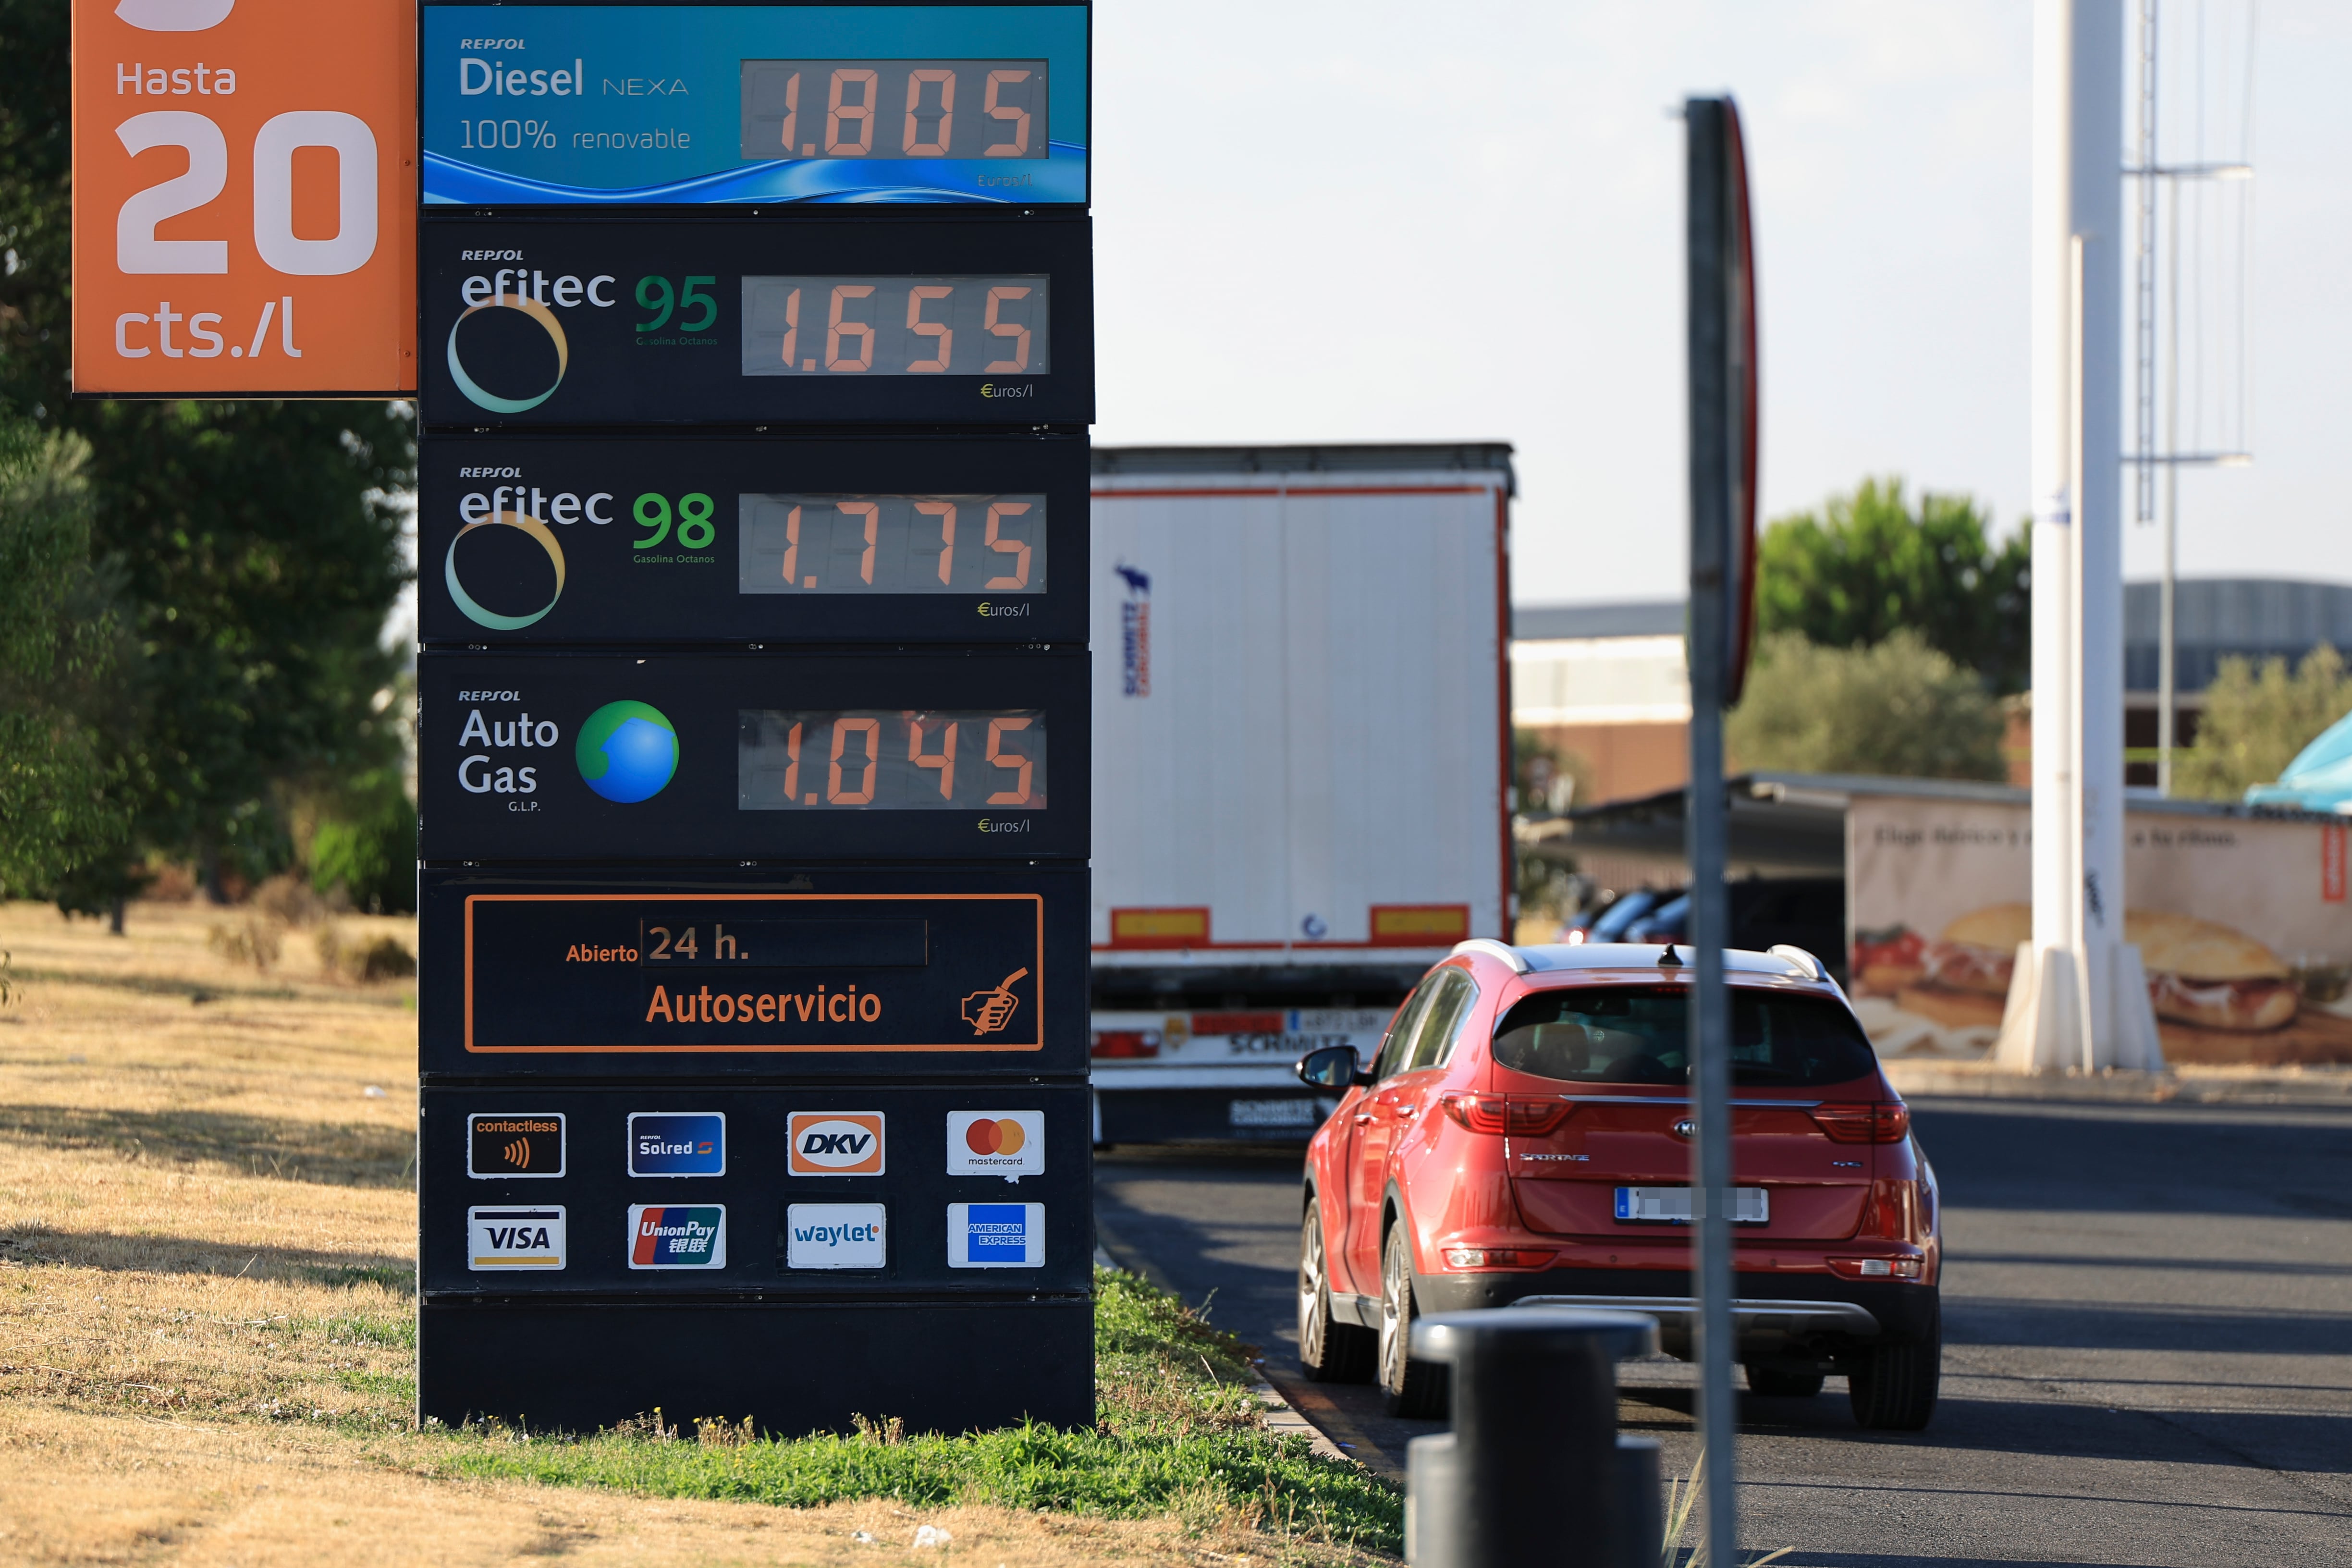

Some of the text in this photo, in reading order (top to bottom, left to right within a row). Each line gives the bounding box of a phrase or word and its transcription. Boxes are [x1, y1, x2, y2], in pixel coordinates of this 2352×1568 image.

[460, 38, 526, 49] REPSOL
[117, 62, 236, 95] Hasta
[460, 58, 689, 96] Diesel NEXA
[781, 69, 1031, 157] 1.805
[461, 120, 690, 149] 100% renovable
[978, 173, 1033, 187] Euros/l
[114, 110, 379, 276] 20
[461, 249, 524, 261] REPSOL
[461, 268, 718, 332] efitec 95
[115, 296, 302, 358] cts./l
[782, 285, 1032, 373] 1.655
[636, 337, 718, 345] Gasolina Octanos
[980, 383, 1033, 398] €uros/l
[460, 467, 522, 478] REPSOL
[459, 485, 715, 549] efitec 98
[782, 502, 1032, 590] 1.775
[633, 554, 715, 564] Gasolina Octanos
[978, 602, 1030, 617] €uros/l
[458, 690, 521, 701] REPSOL
[458, 709, 559, 747] Auto
[784, 718, 1033, 806] 1.045
[458, 754, 538, 794] Gas
[508, 801, 541, 812] G.L.P.
[978, 818, 1030, 833] €uros/l
[566, 924, 749, 962] Abierto 24 h.
[646, 985, 882, 1023] Autoservicio
[477, 1120, 558, 1132] contactless
[640, 1141, 693, 1155] Solred
[802, 1134, 872, 1154] DKV
[1519, 1153, 1590, 1162] SPORTAGE
[483, 1227, 551, 1250] VISA
[641, 1221, 715, 1241] UnionPay
[795, 1223, 879, 1247] waylet
[968, 1224, 1022, 1234] AMERICAN
[669, 1238, 709, 1253] 银联
[979, 1235, 1026, 1245] EXPRESS
